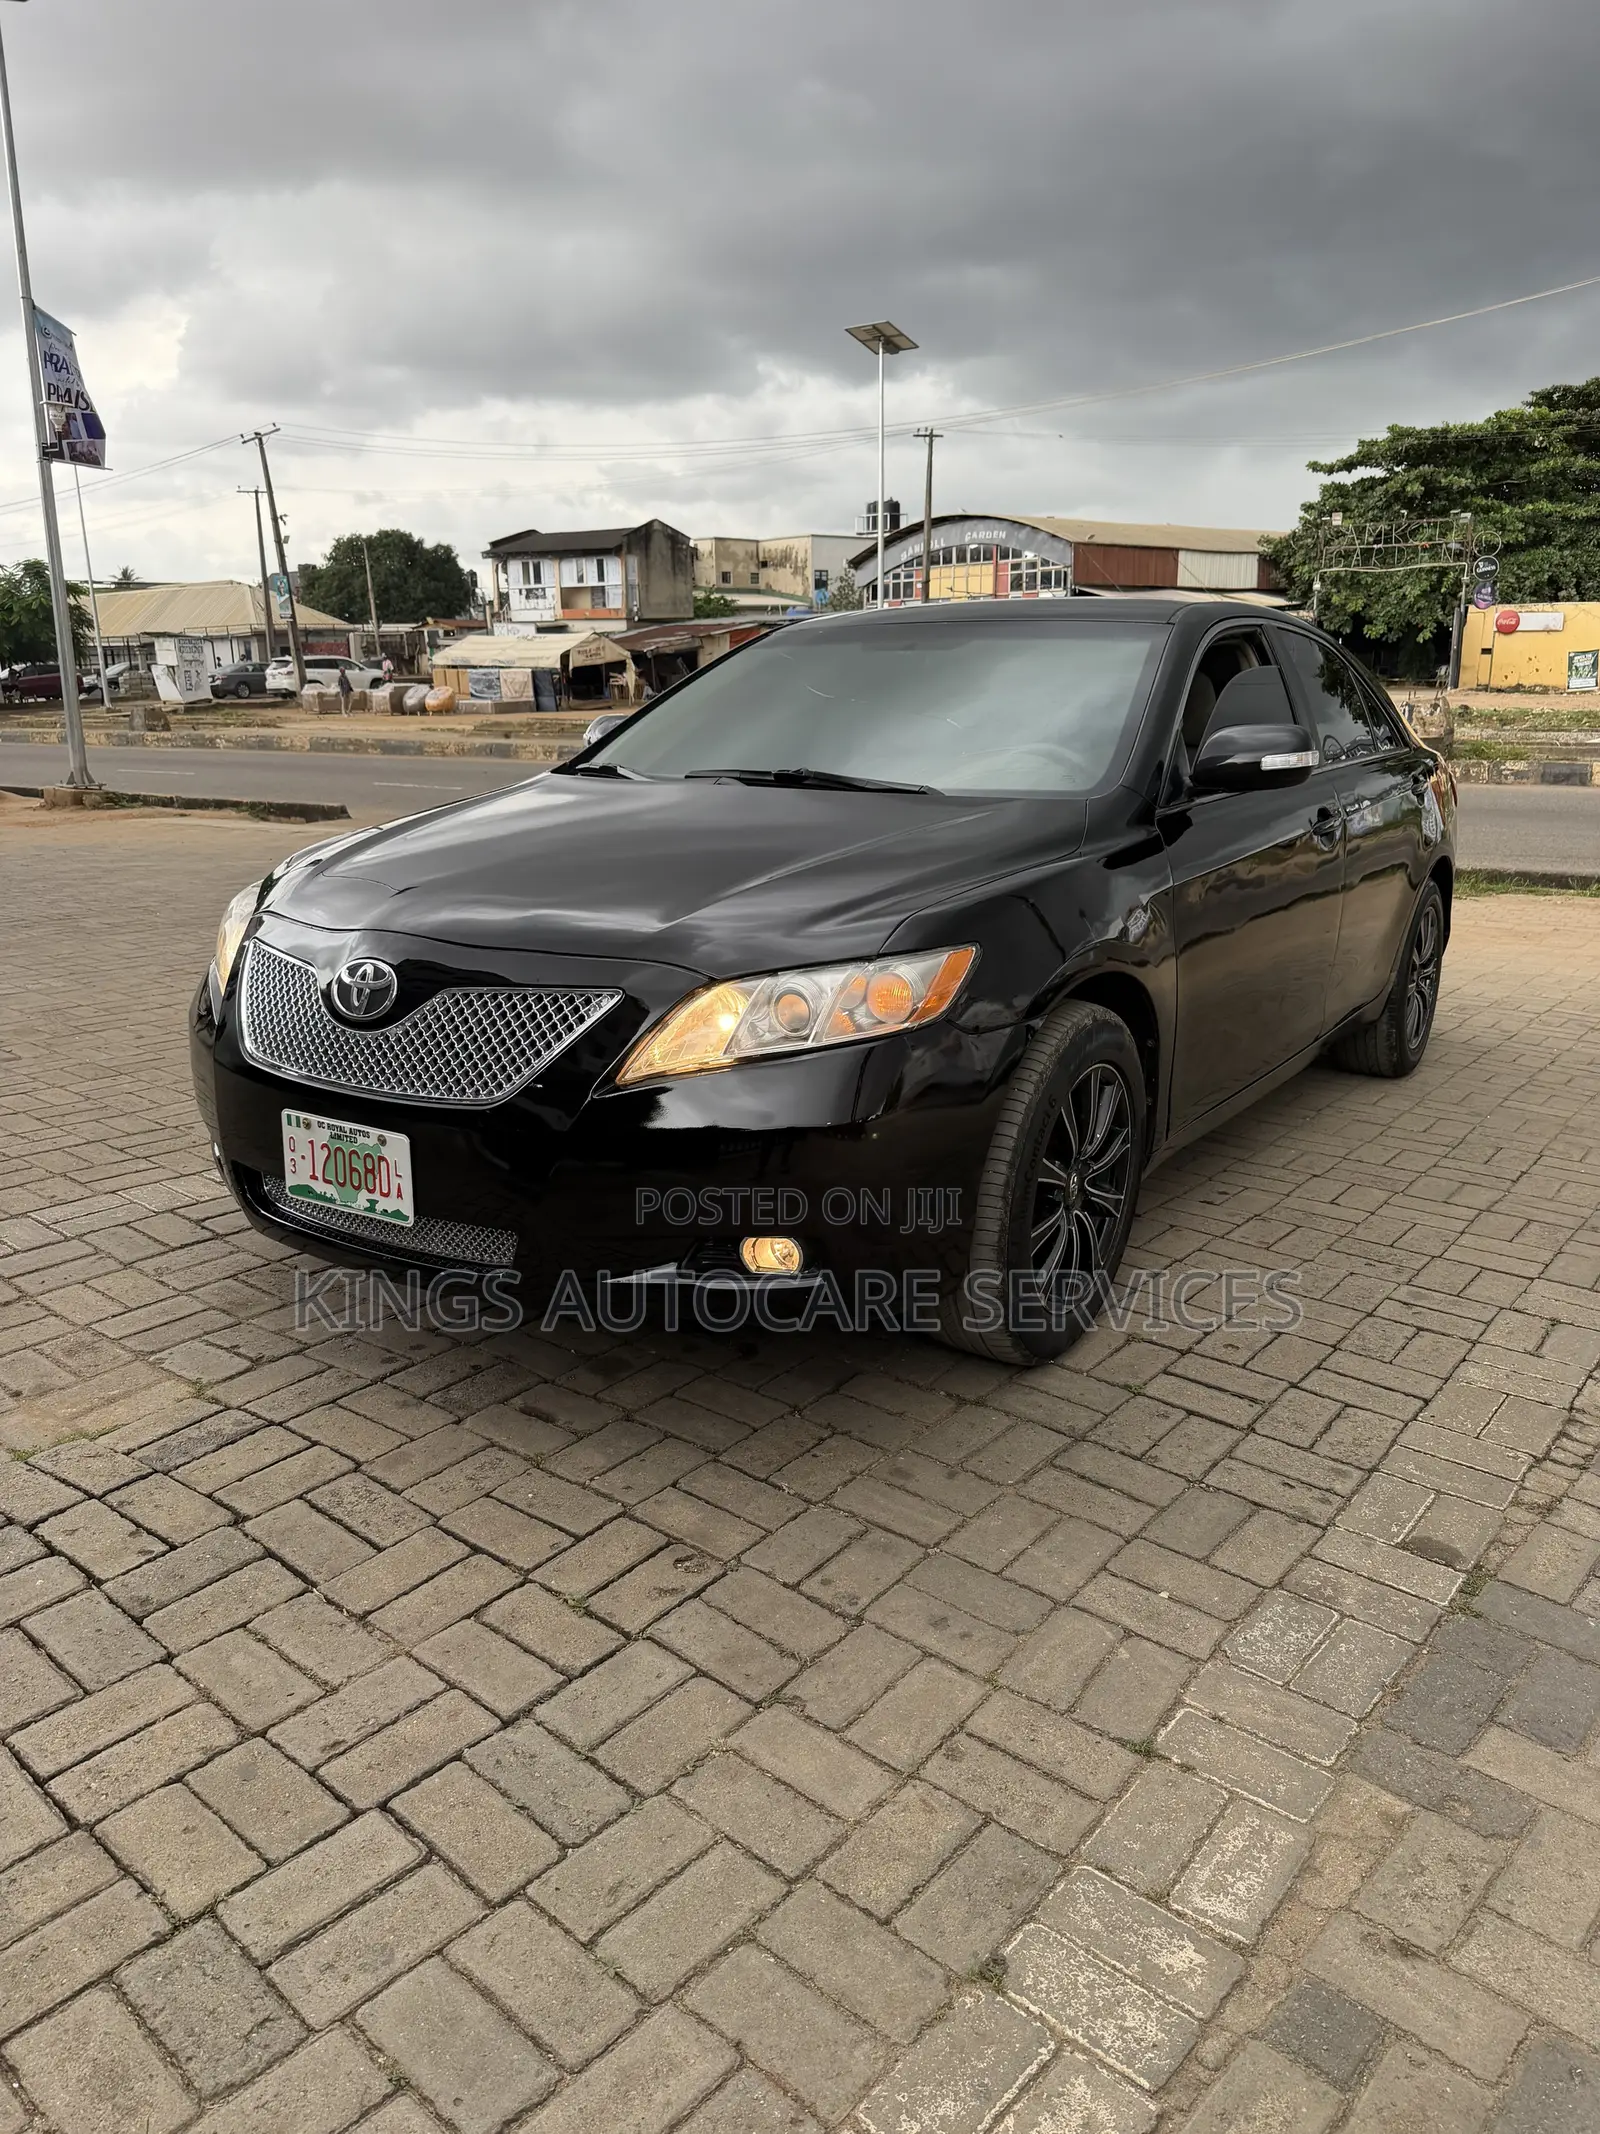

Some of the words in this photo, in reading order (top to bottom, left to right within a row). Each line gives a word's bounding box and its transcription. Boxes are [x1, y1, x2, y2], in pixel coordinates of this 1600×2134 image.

[47, 382, 97, 413] PRAIS
[964, 530, 1007, 543] GARDEN
[326, 1122, 348, 1135] ROYAL
[348, 1127, 371, 1139] AUTOS
[329, 1131, 359, 1144] LIMITED
